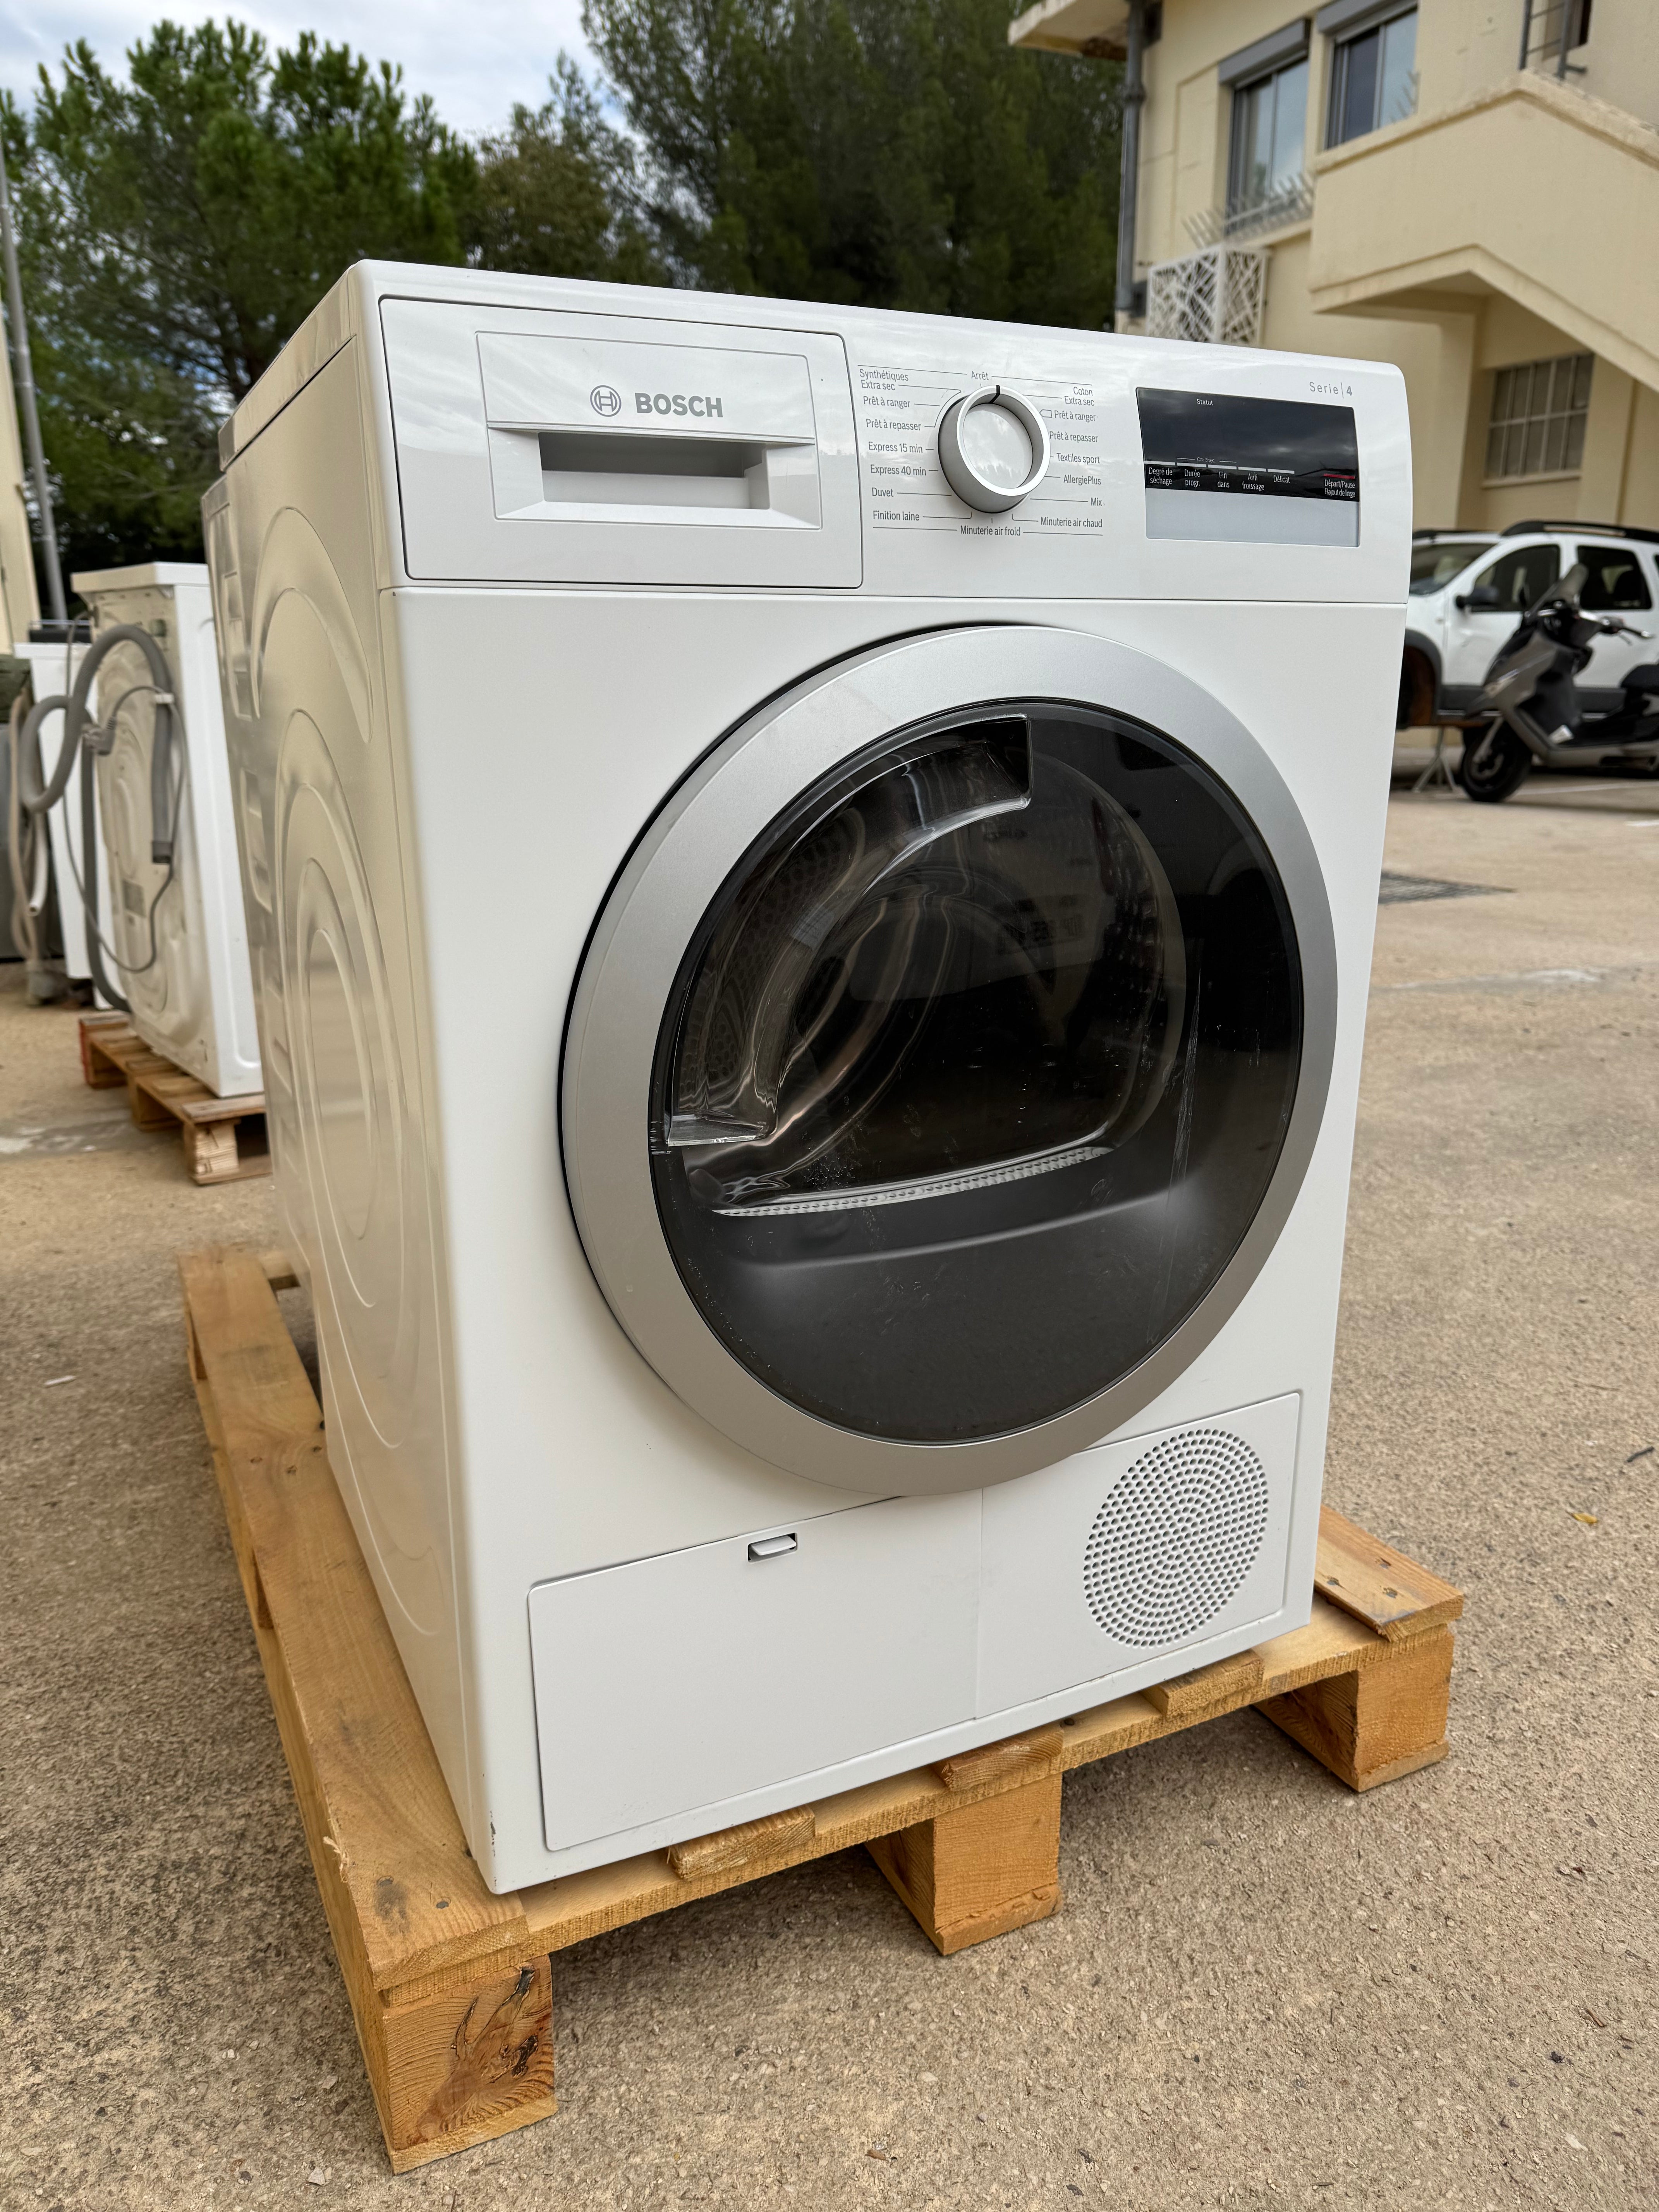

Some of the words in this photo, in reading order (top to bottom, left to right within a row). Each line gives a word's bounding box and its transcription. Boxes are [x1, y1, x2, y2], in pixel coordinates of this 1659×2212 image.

[860, 369, 908, 382] Synthétiques
[971, 371, 989, 380] Arrêt
[861, 380, 881, 389] Extra
[1073, 386, 1092, 396] Coton
[635, 393, 723, 418] BOSCH
[864, 396, 879, 405] Prêt
[881, 397, 885, 406] à
[887, 400, 910, 409] ranger
[1065, 396, 1082, 405] Extra
[1054, 410, 1068, 419] Prêt
[1070, 411, 1073, 419] à
[1075, 414, 1096, 422] ranger
[866, 419, 882, 428] Prêt
[884, 420, 888, 428] à
[890, 422, 921, 431] repasser
[1049, 431, 1063, 440] Prêt
[1070, 434, 1098, 443] repasser
[869, 441, 898, 452] Express
[899, 443, 907, 452] 15
[910, 444, 922, 453] min
[1056, 453, 1081, 462] Textiles
[1083, 456, 1100, 464] sport
[871, 465, 900, 476] Express
[901, 467, 911, 475] 40
[913, 467, 926, 476] min
[1149, 467, 1165, 476] Degré
[1184, 469, 1200, 477] Durée
[1063, 475, 1101, 486] AllergiePlus
[1150, 476, 1172, 486] séchage
[1248, 473, 1258, 481] Anti
[1273, 475, 1290, 483] Délicat
[1185, 480, 1200, 488] progr.
[1242, 481, 1264, 492] froissage
[1324, 479, 1355, 489] Départ/Pause
[872, 488, 893, 497] Duvet
[1091, 498, 1102, 506] Mix
[873, 510, 900, 520] Finition
[902, 511, 919, 521] laine
[1041, 517, 1072, 526] Minuterie
[1073, 518, 1081, 526] air
[1083, 519, 1102, 527] chaud
[961, 526, 993, 535] Minuterie
[994, 527, 1003, 535] air
[1005, 527, 1020, 536] froid
